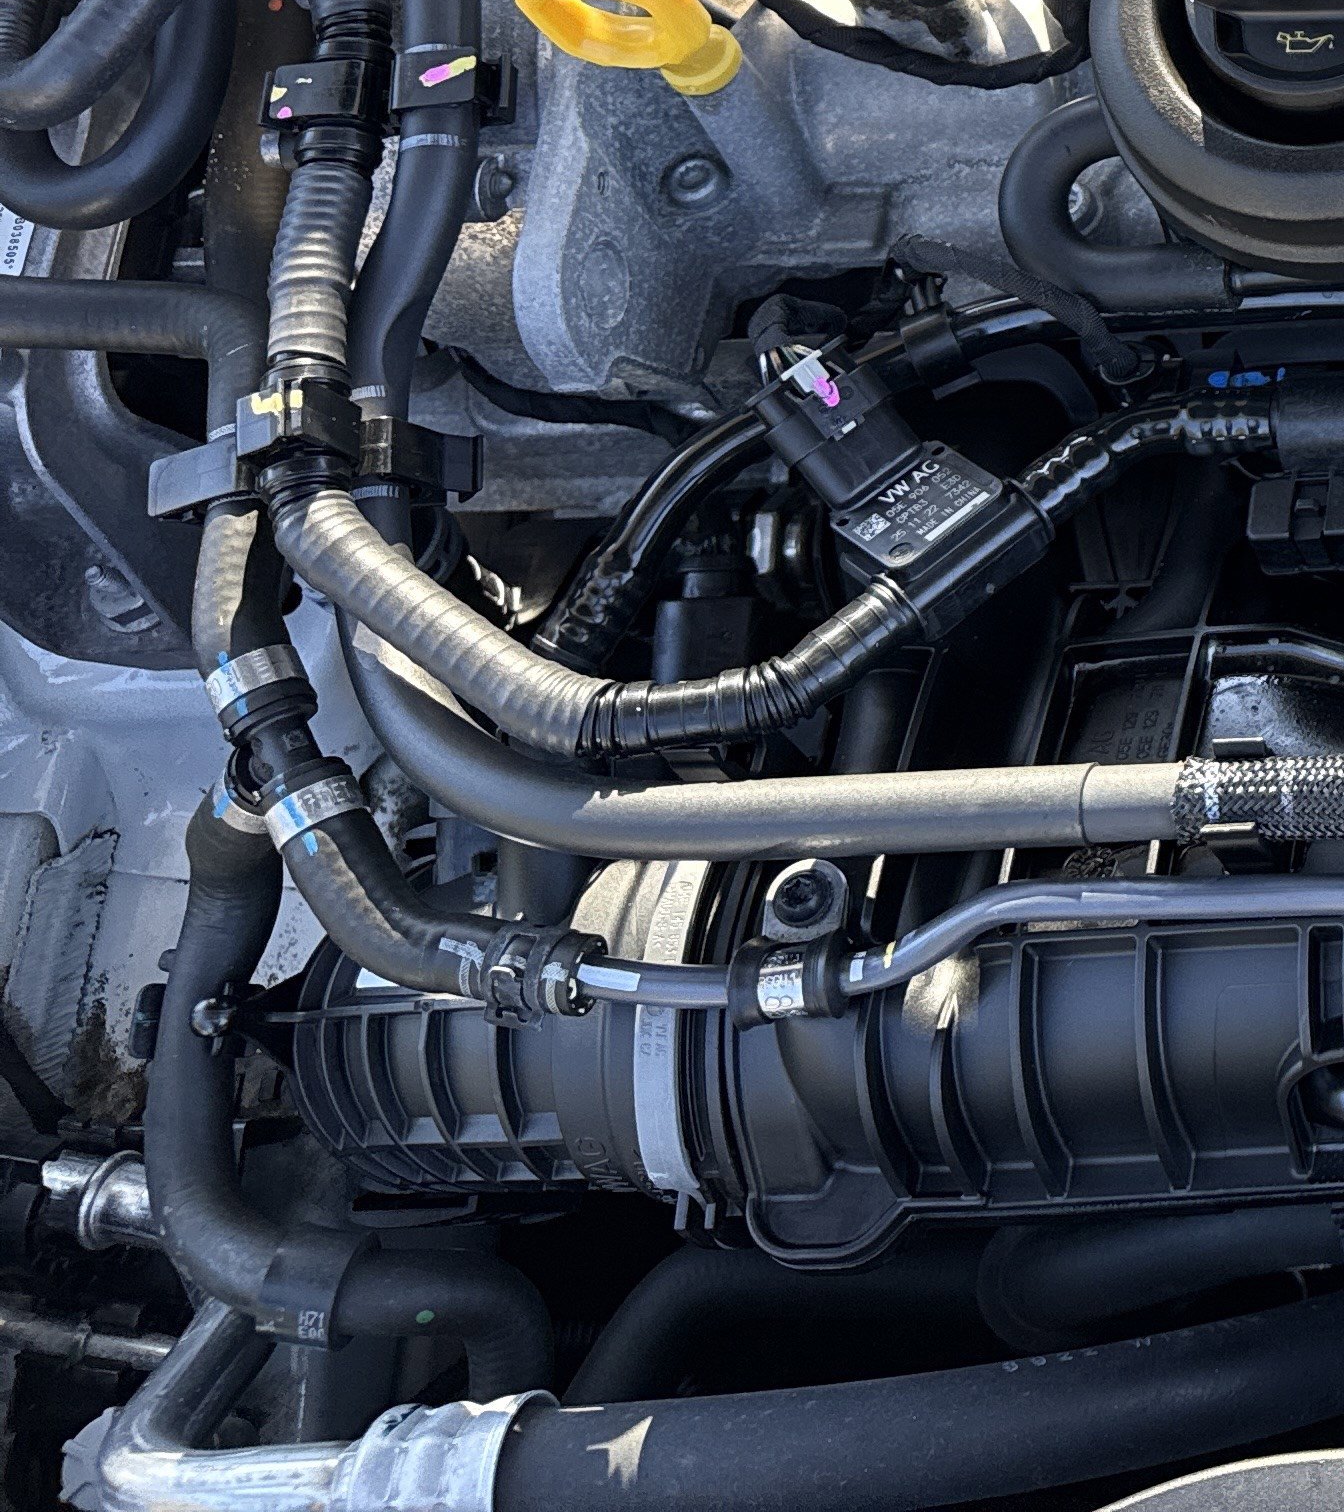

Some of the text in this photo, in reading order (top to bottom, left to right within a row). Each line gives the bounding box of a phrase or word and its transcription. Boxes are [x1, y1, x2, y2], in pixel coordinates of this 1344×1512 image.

[878, 460, 940, 503] VW AG
[886, 501, 908, 518] 05E
[931, 467, 951, 483] 052
[916, 519, 939, 536] MADE
[954, 486, 981, 506] CHINA
